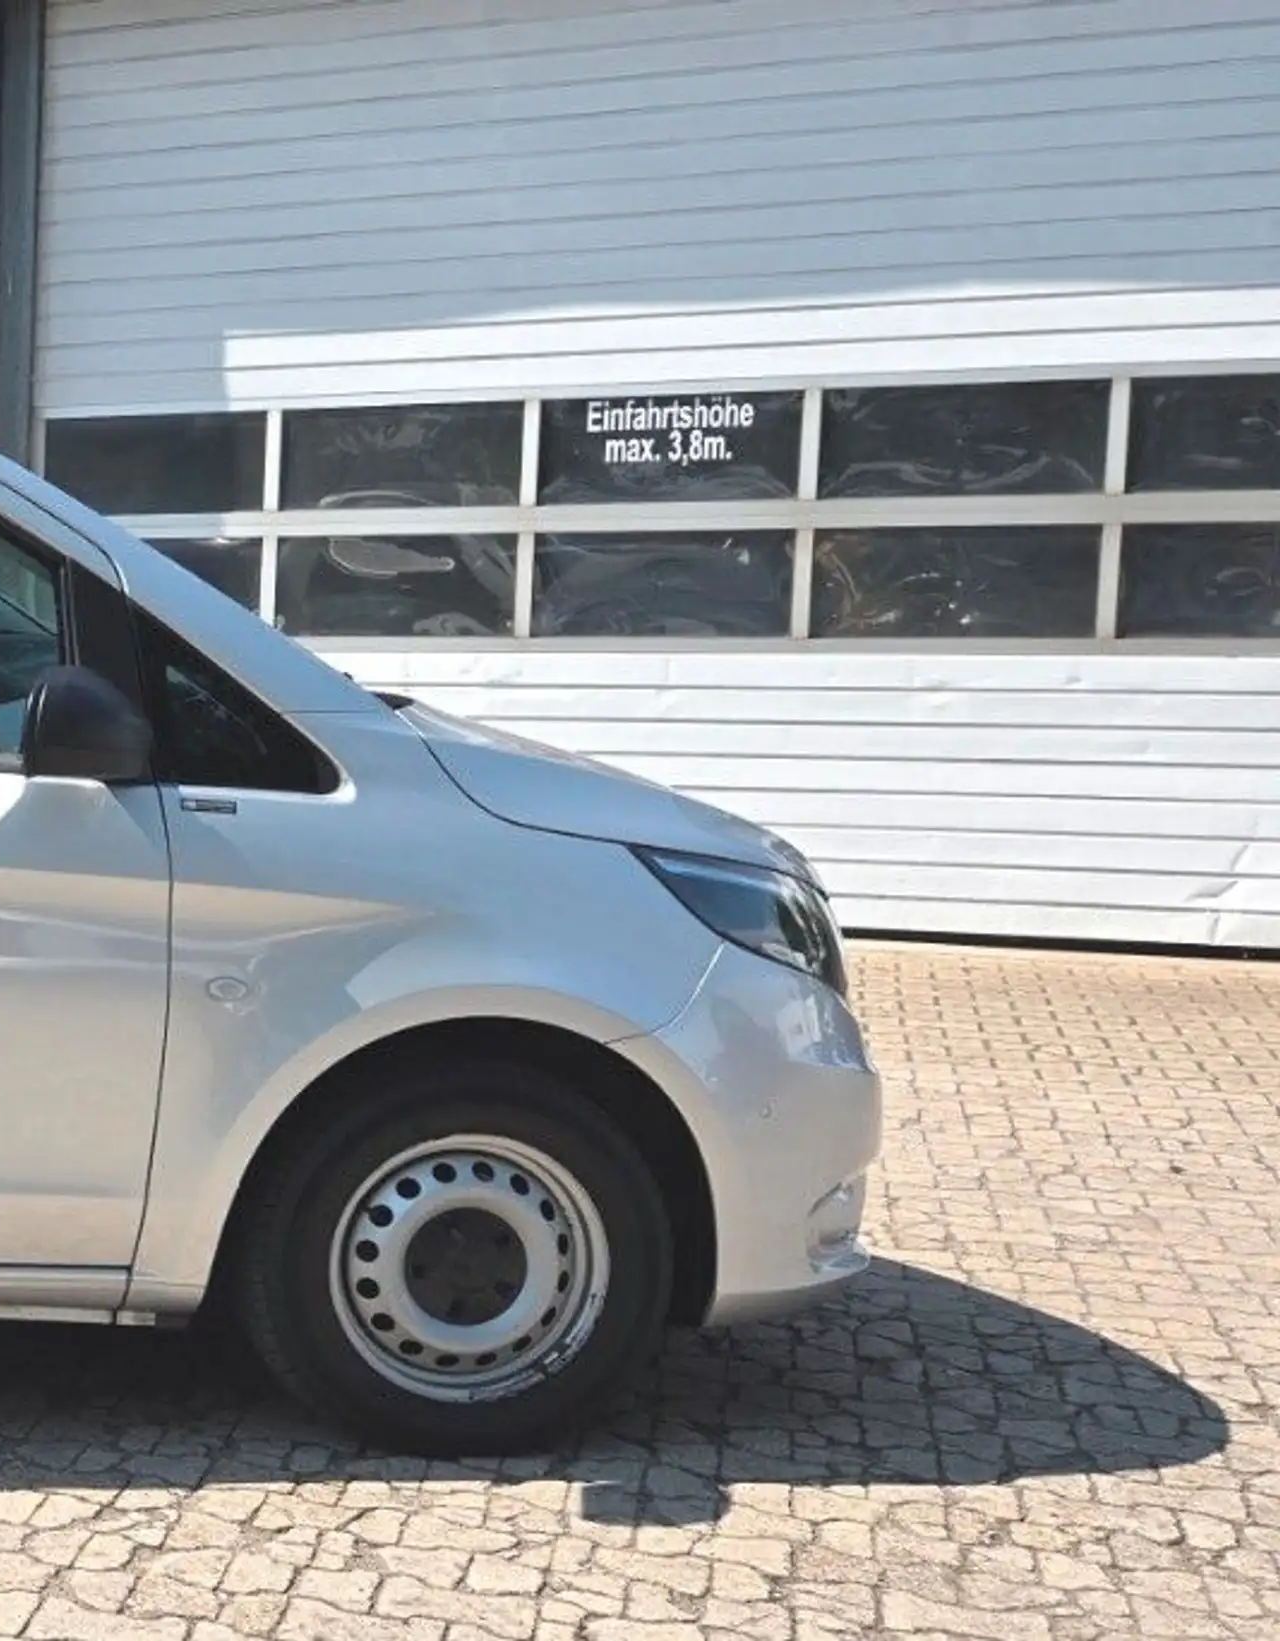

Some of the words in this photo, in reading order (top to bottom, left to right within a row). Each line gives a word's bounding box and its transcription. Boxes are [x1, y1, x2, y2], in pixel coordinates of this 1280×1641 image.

[586, 396, 755, 433] Einfahrtshöhe
[604, 437, 661, 462] max.
[668, 429, 733, 467] 3,8m.
